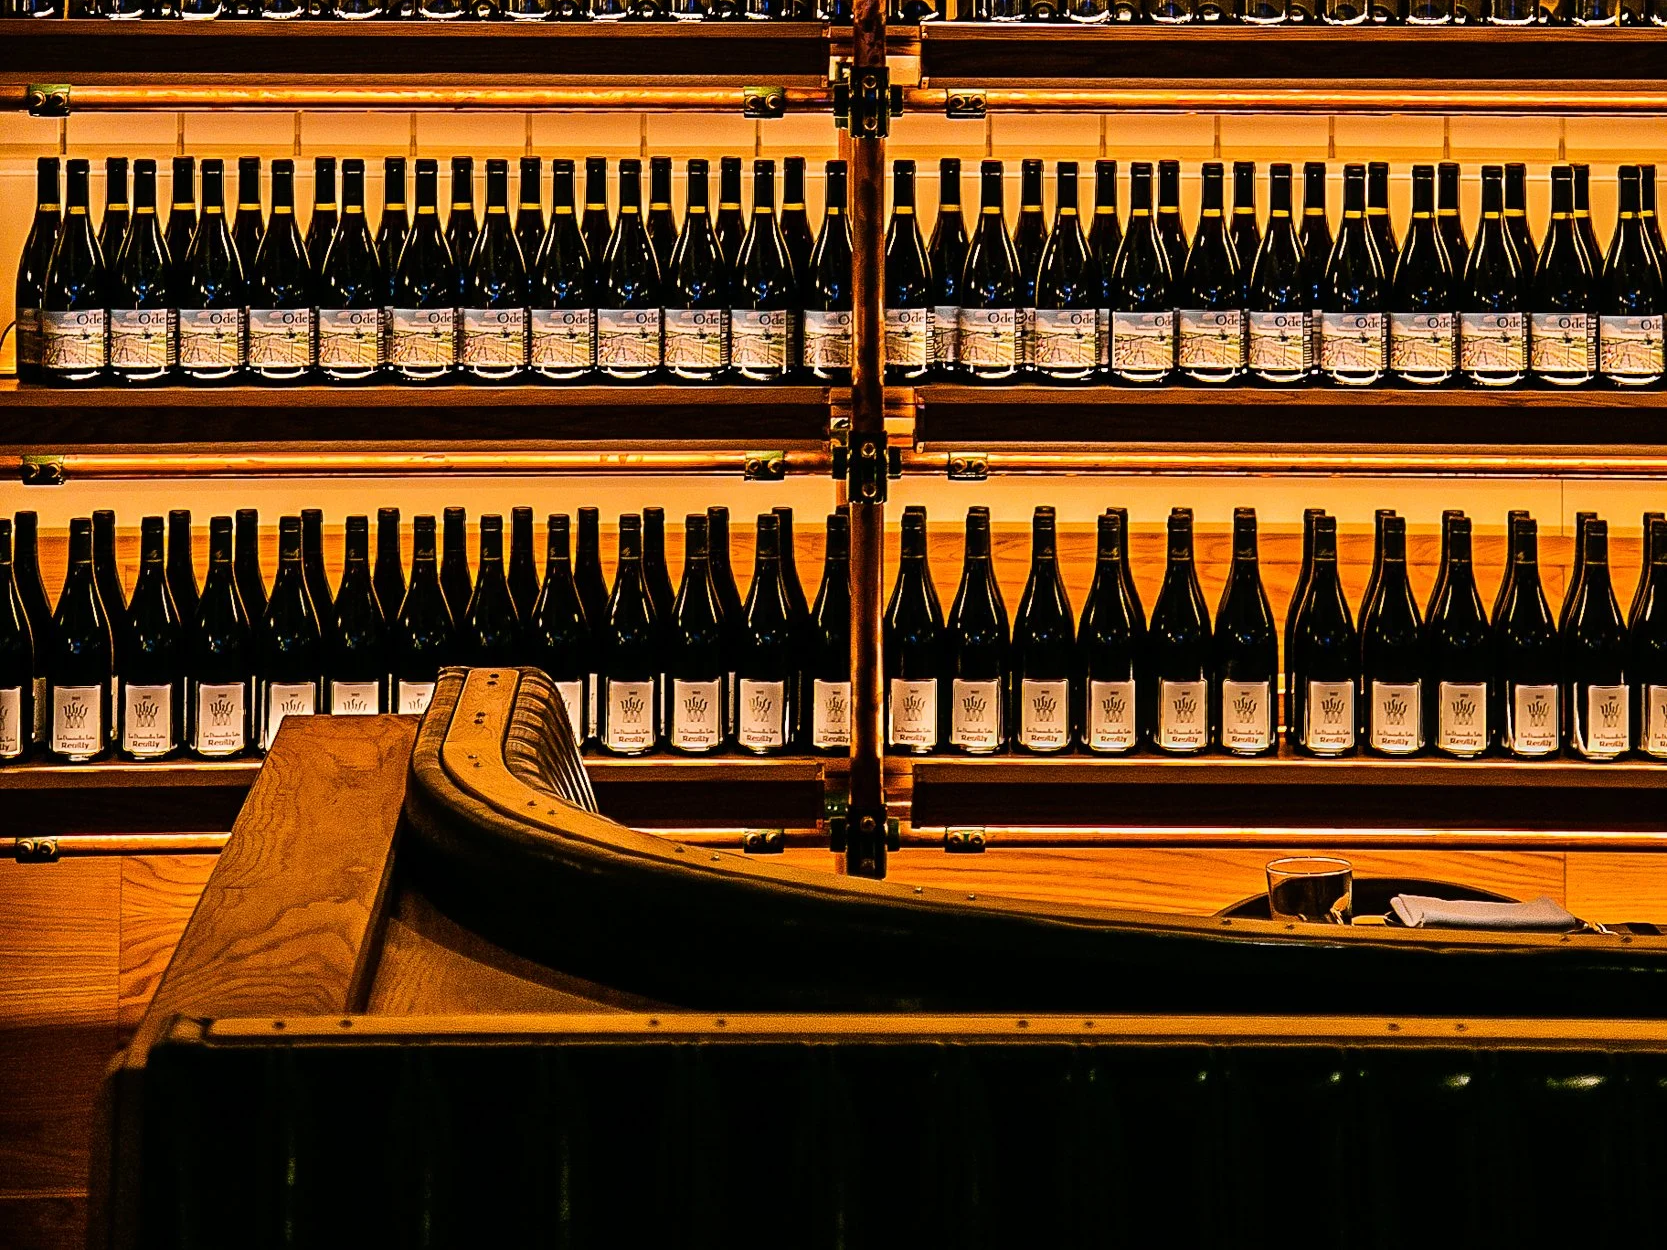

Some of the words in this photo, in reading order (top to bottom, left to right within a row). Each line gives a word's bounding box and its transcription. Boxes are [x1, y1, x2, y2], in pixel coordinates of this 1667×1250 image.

[76, 313, 103, 325] Ode
[138, 313, 165, 325] Ode
[209, 313, 237, 325] Ode
[281, 313, 308, 325] Ode
[349, 313, 376, 325] Ode
[427, 313, 452, 325] Ode
[496, 313, 522, 325] Ode
[562, 313, 588, 325] Ode
[635, 313, 658, 325] Ode
[693, 313, 719, 325] Ode
[758, 314, 785, 326] Ode
[898, 312, 924, 324] Ode
[987, 312, 1013, 324] Ode
[1017, 312, 1035, 324] Od
[1070, 313, 1095, 325] Ode
[1214, 315, 1240, 327] Ode
[1274, 316, 1302, 328] Ode
[1355, 317, 1380, 329] Ode
[1427, 317, 1451, 329] Ode
[1496, 317, 1521, 329] Ode
[1558, 318, 1585, 330] Ode
